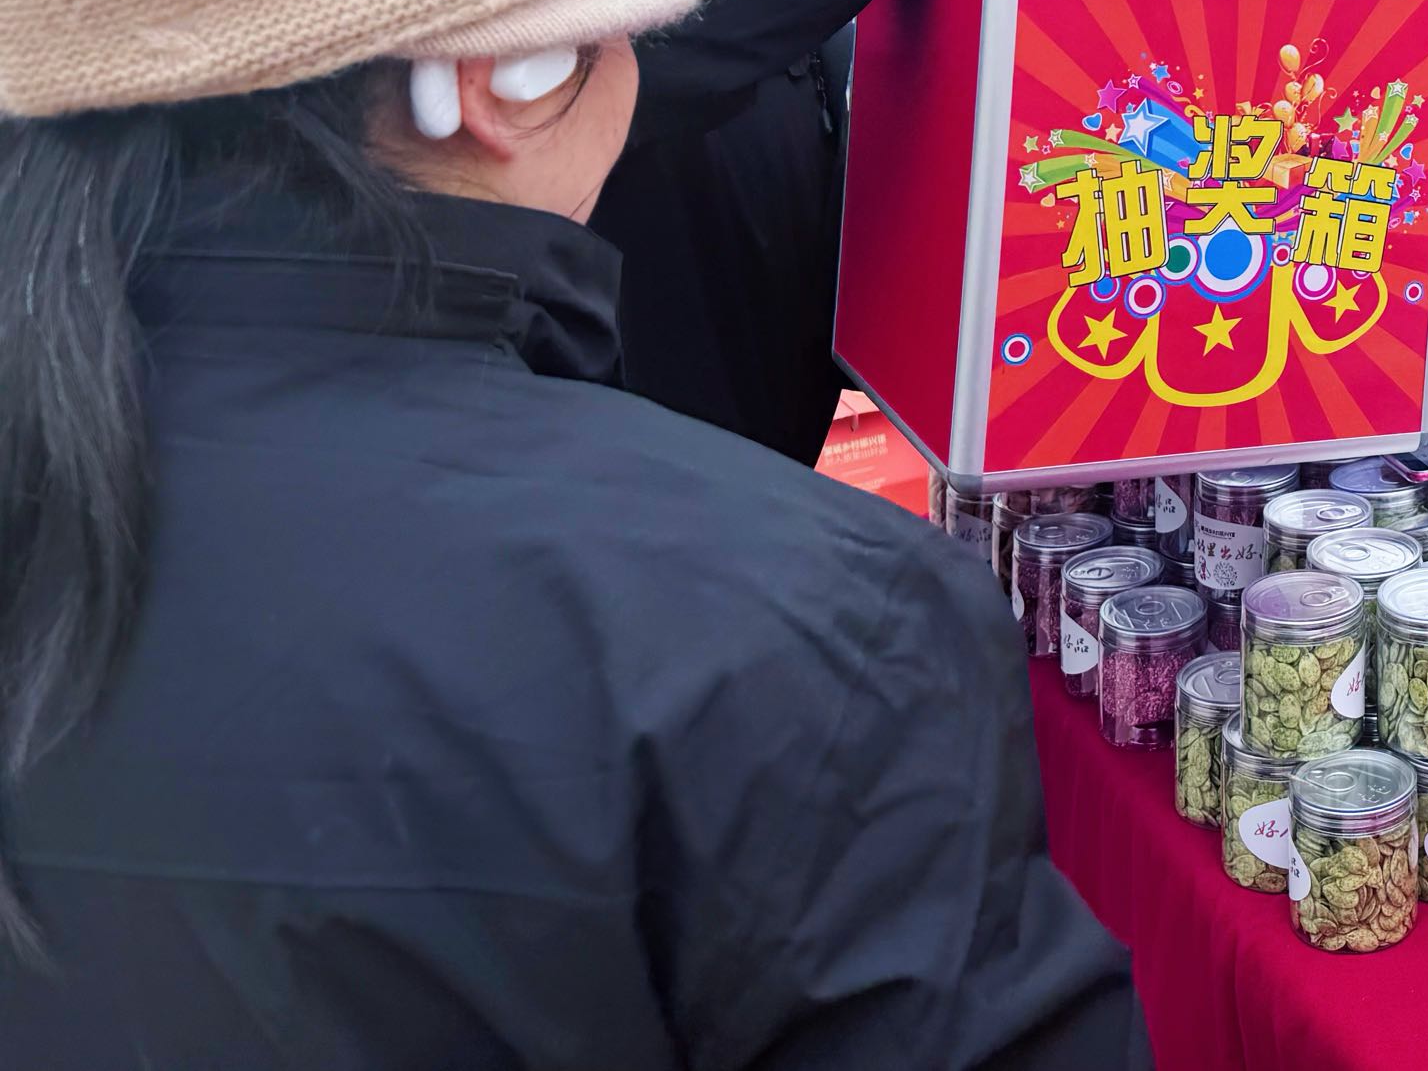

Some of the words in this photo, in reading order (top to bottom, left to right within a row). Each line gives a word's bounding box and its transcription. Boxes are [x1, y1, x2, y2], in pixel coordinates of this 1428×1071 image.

[1056, 115, 1397, 287] 抽奖箱
[1197, 538, 1263, 561] 故里出好
